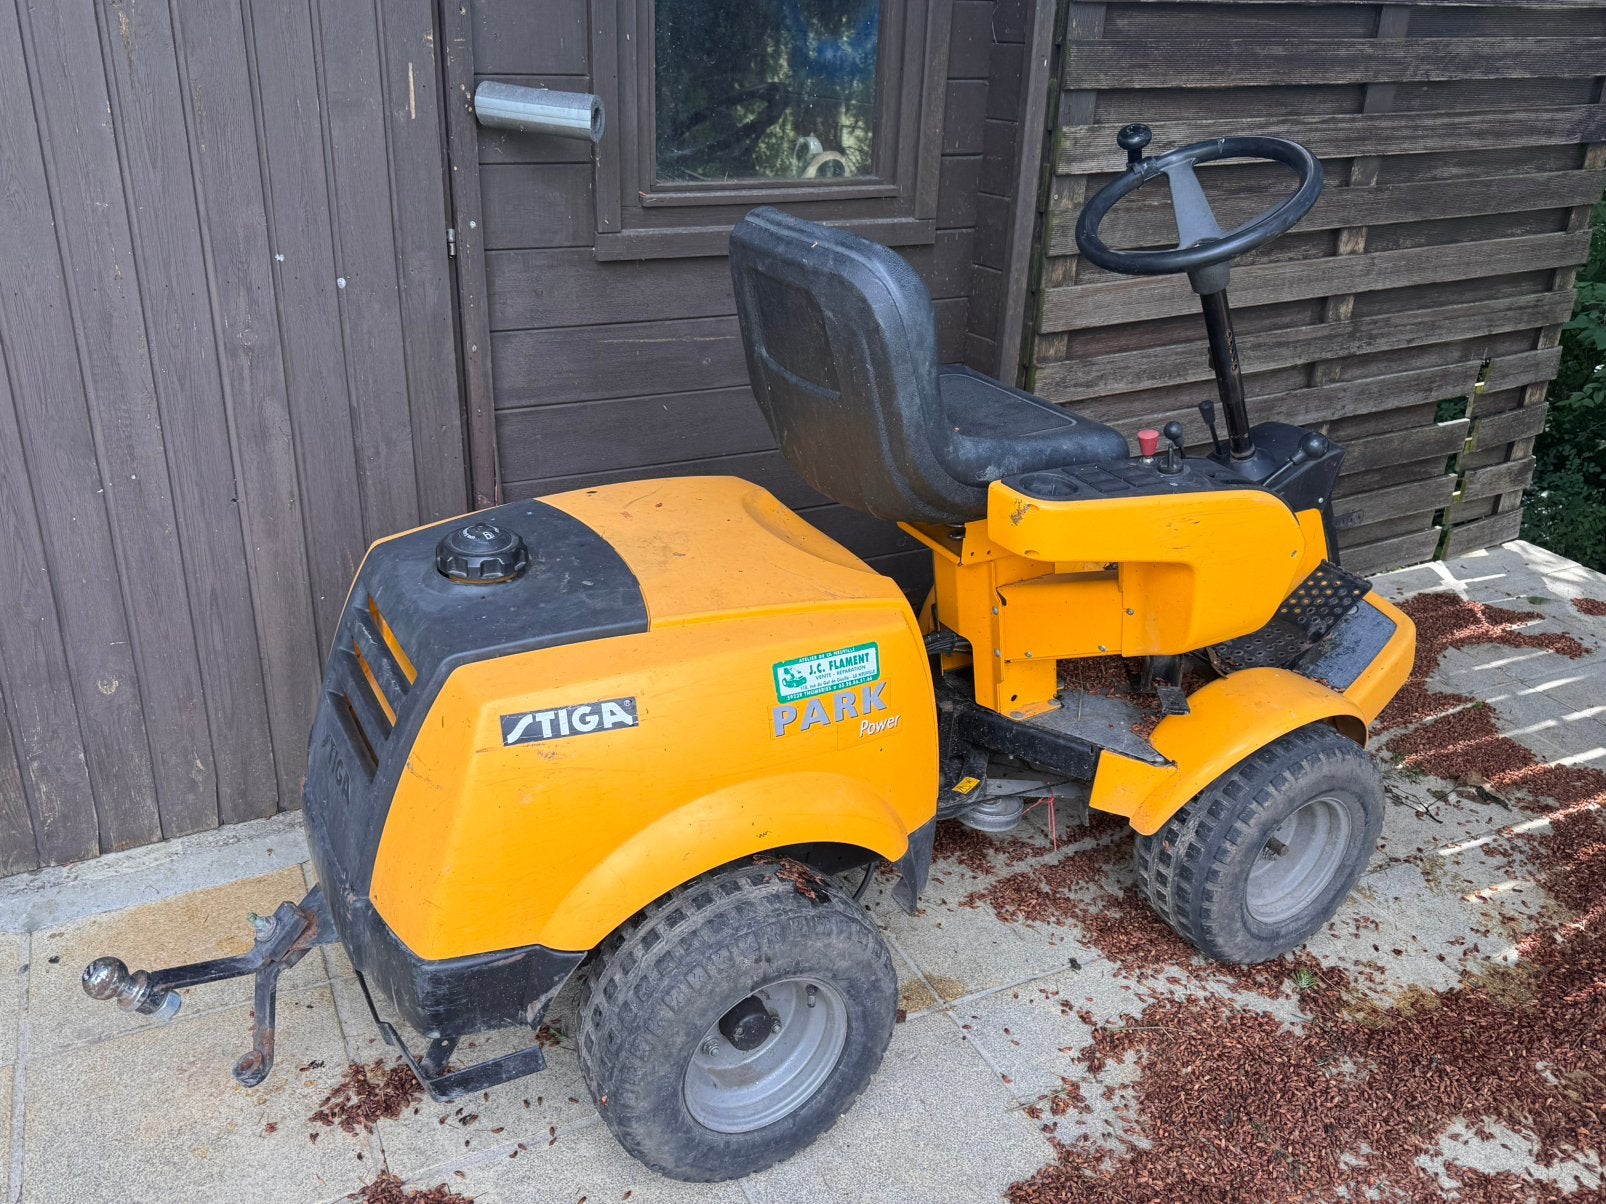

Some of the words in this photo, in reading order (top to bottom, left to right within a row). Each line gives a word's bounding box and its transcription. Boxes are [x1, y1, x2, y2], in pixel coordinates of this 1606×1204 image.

[809, 663, 826, 676] J.C.
[829, 652, 870, 671] FLAMENT
[815, 672, 832, 680] VENTE
[773, 682, 887, 737] PARK
[507, 702, 633, 744] STIGA
[860, 714, 902, 738] Power
